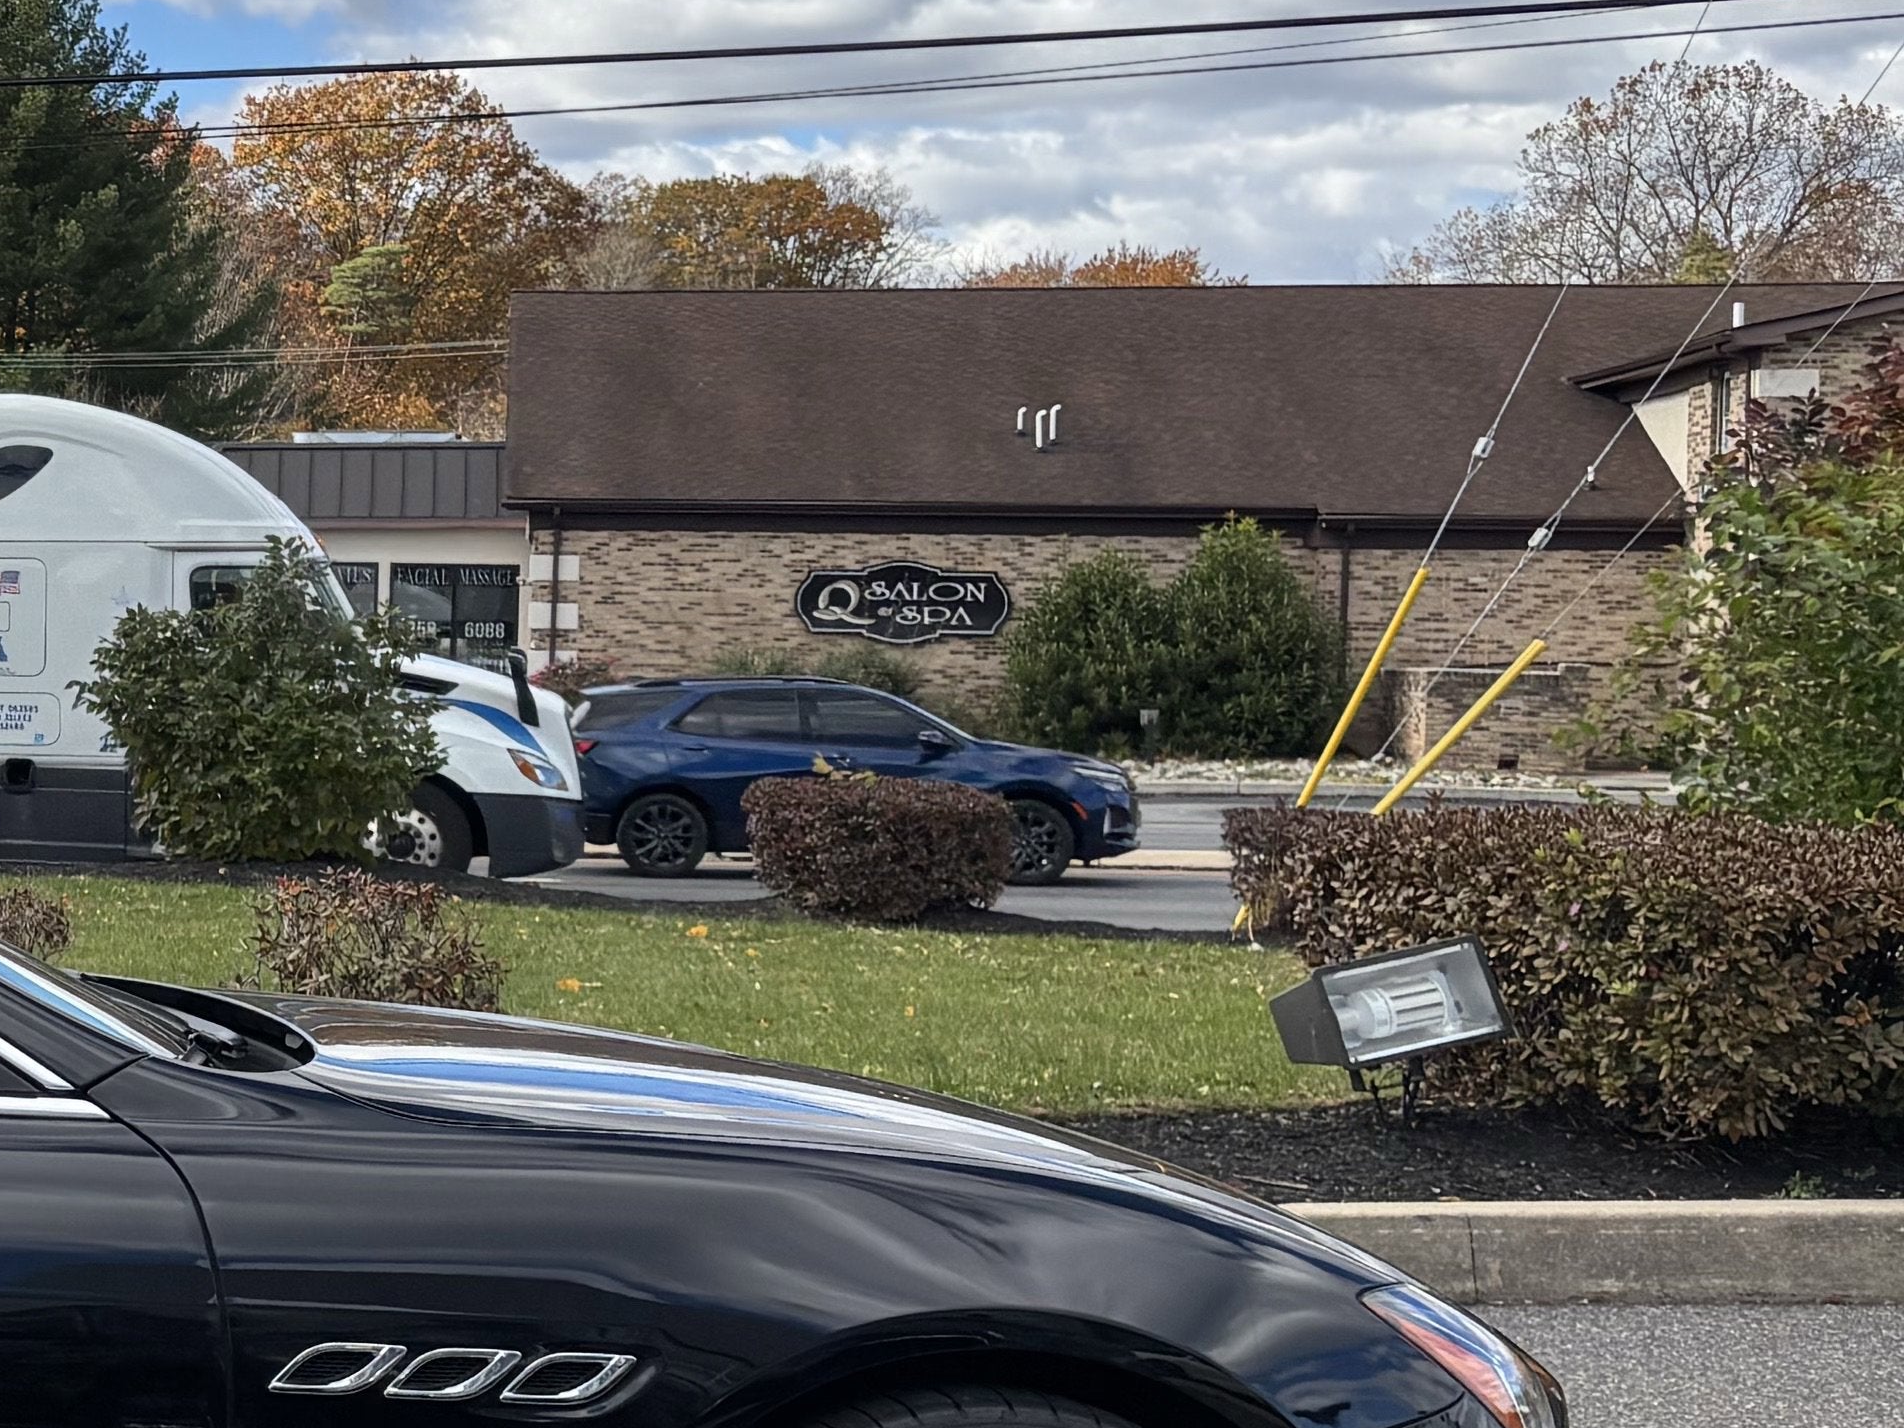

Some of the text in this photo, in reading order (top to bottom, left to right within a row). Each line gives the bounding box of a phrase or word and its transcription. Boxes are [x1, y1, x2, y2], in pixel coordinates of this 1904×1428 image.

[397, 567, 514, 587] FACIAL MASSAGE
[812, 580, 988, 625] Q SALON
[895, 605, 973, 625] SPA
